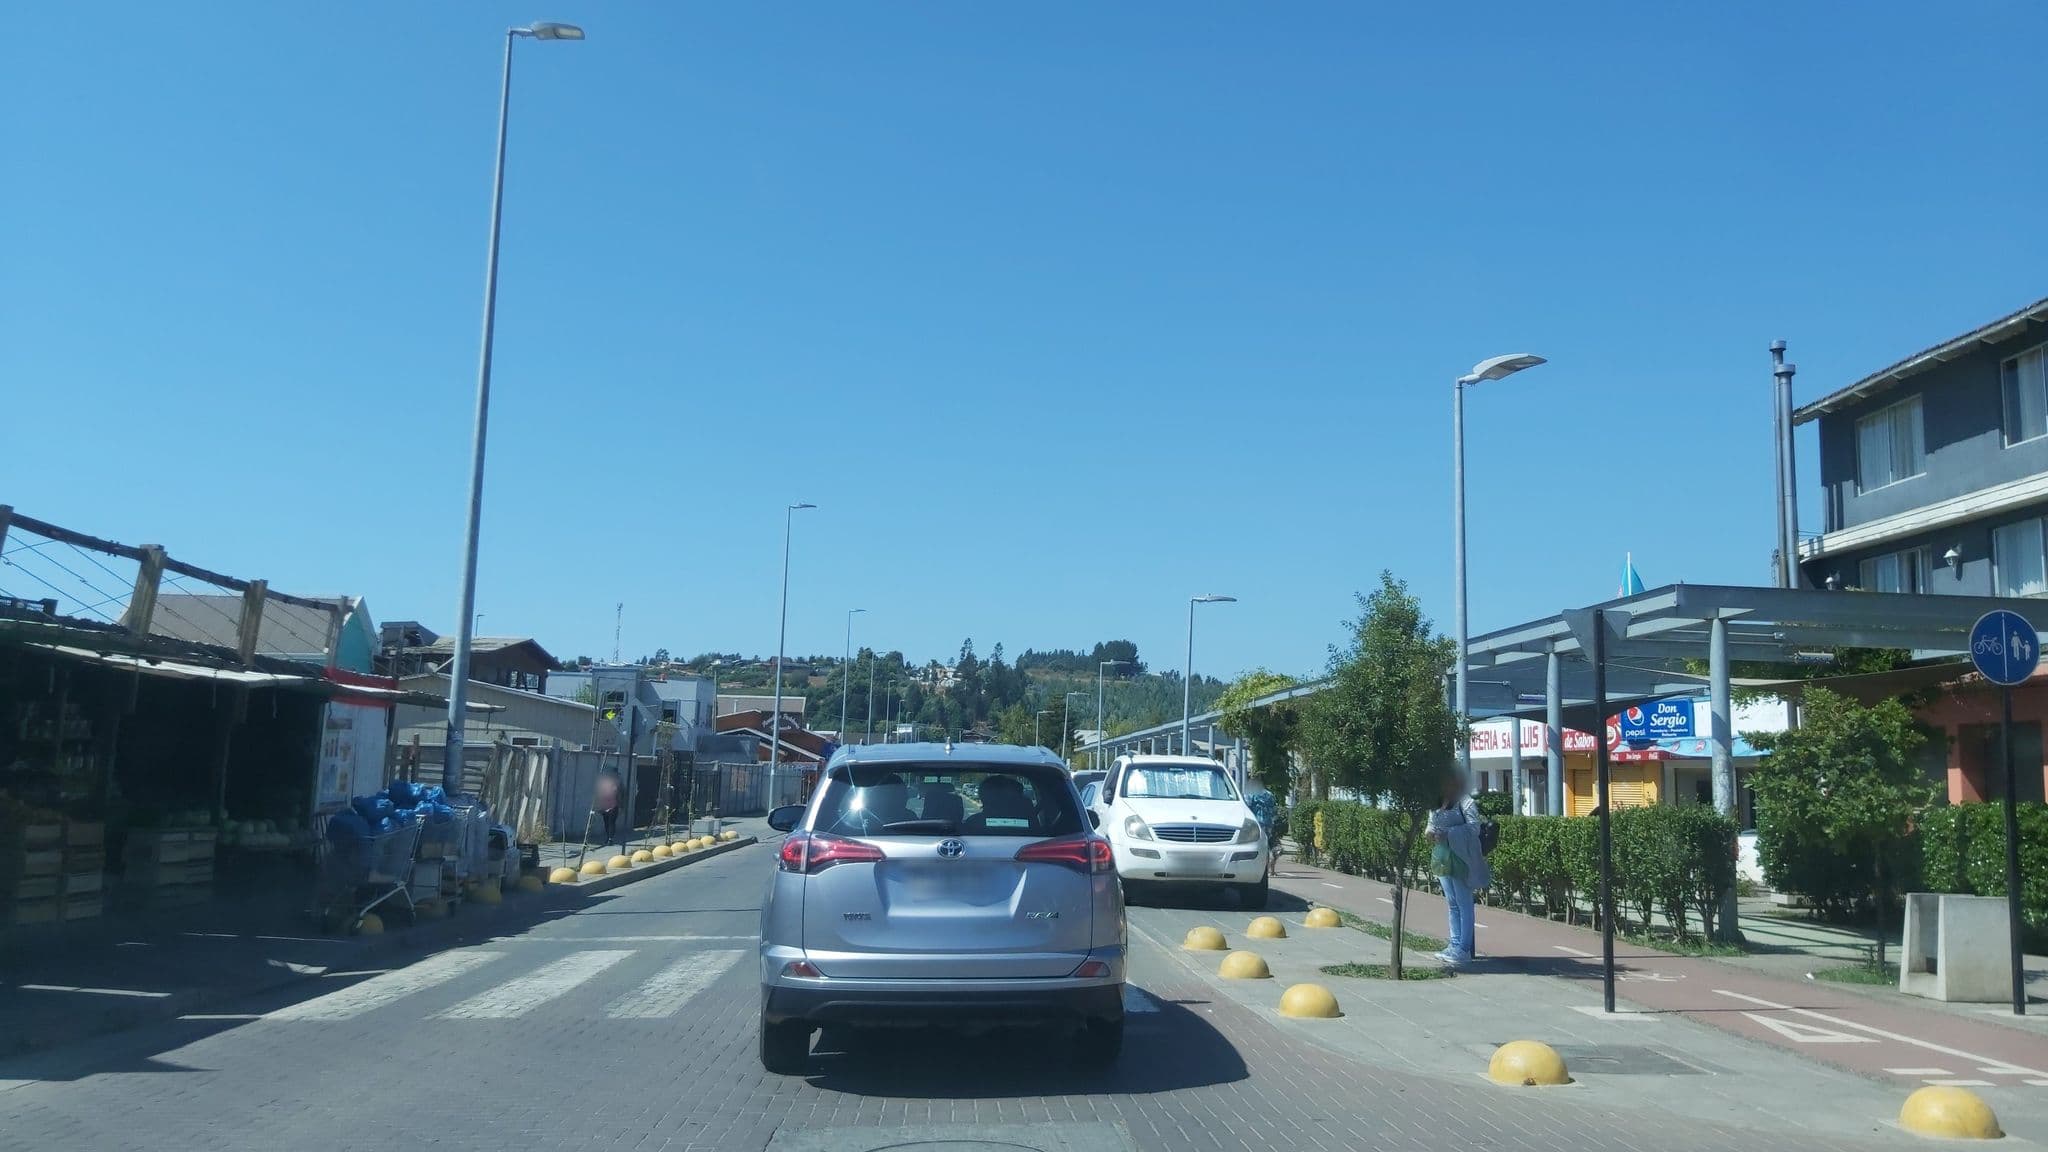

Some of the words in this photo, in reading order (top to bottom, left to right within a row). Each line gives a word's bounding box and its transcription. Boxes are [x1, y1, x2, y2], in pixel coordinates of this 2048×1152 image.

[1658, 703, 1677, 713] Don
[1650, 713, 1686, 728] Sergio
[1625, 728, 1645, 737] pepsi
[1565, 734, 1573, 748] de
[1574, 732, 1594, 748] Sabor
